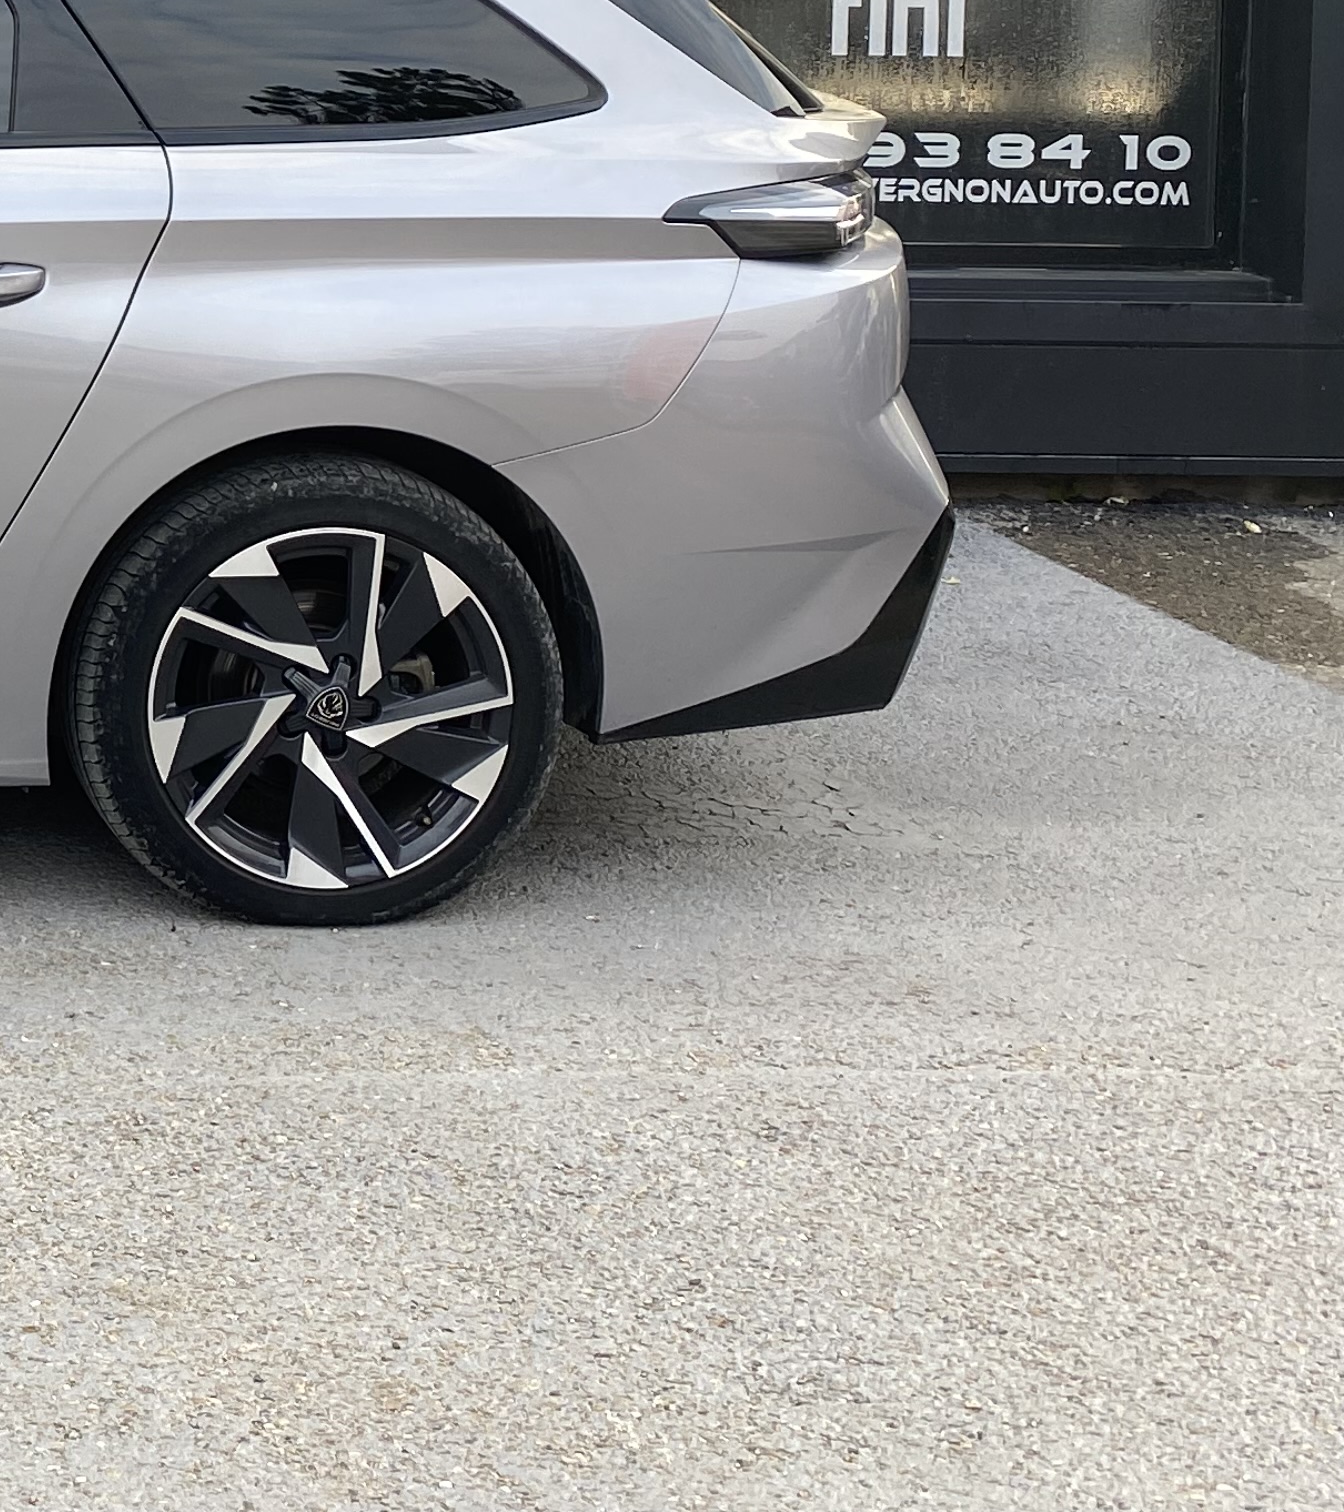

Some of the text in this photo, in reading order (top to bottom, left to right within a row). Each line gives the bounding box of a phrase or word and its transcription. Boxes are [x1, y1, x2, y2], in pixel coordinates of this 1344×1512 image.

[863, 133, 1192, 171] 93 84 10
